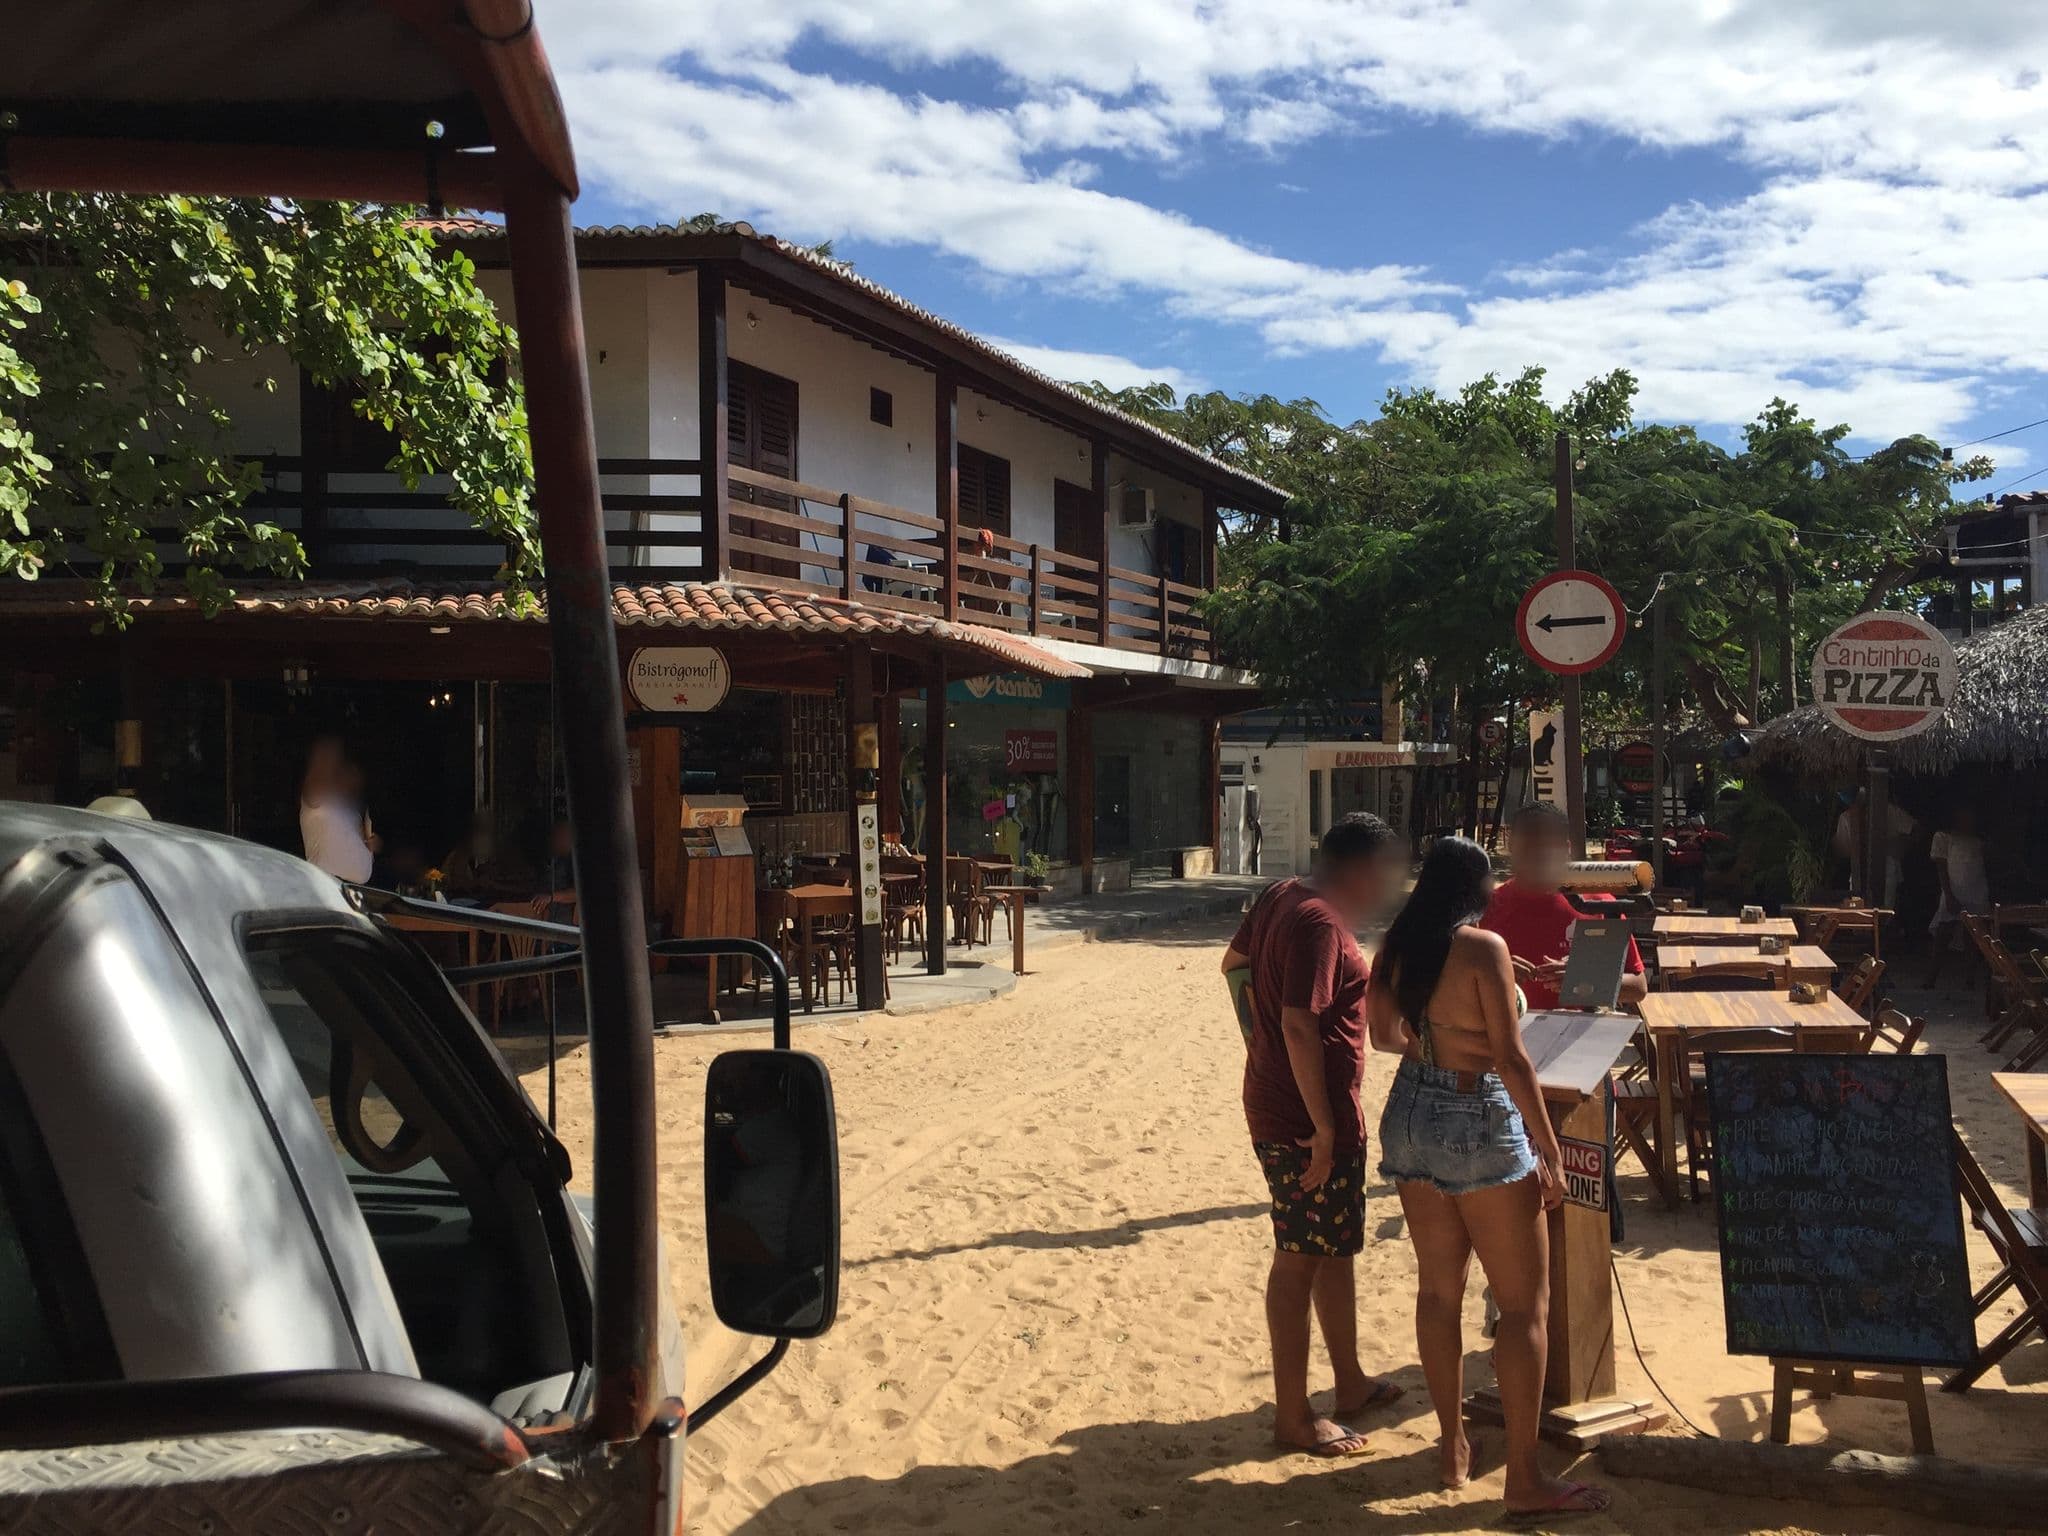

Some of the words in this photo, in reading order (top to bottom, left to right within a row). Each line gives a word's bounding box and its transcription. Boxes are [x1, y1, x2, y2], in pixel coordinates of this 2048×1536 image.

[1823, 641, 1922, 667] Cantinho
[1921, 652, 1940, 668] da
[1822, 668, 1945, 707] PIZZA
[1007, 736, 1031, 767] 30%
[1335, 751, 1405, 767] LAUNDRY
